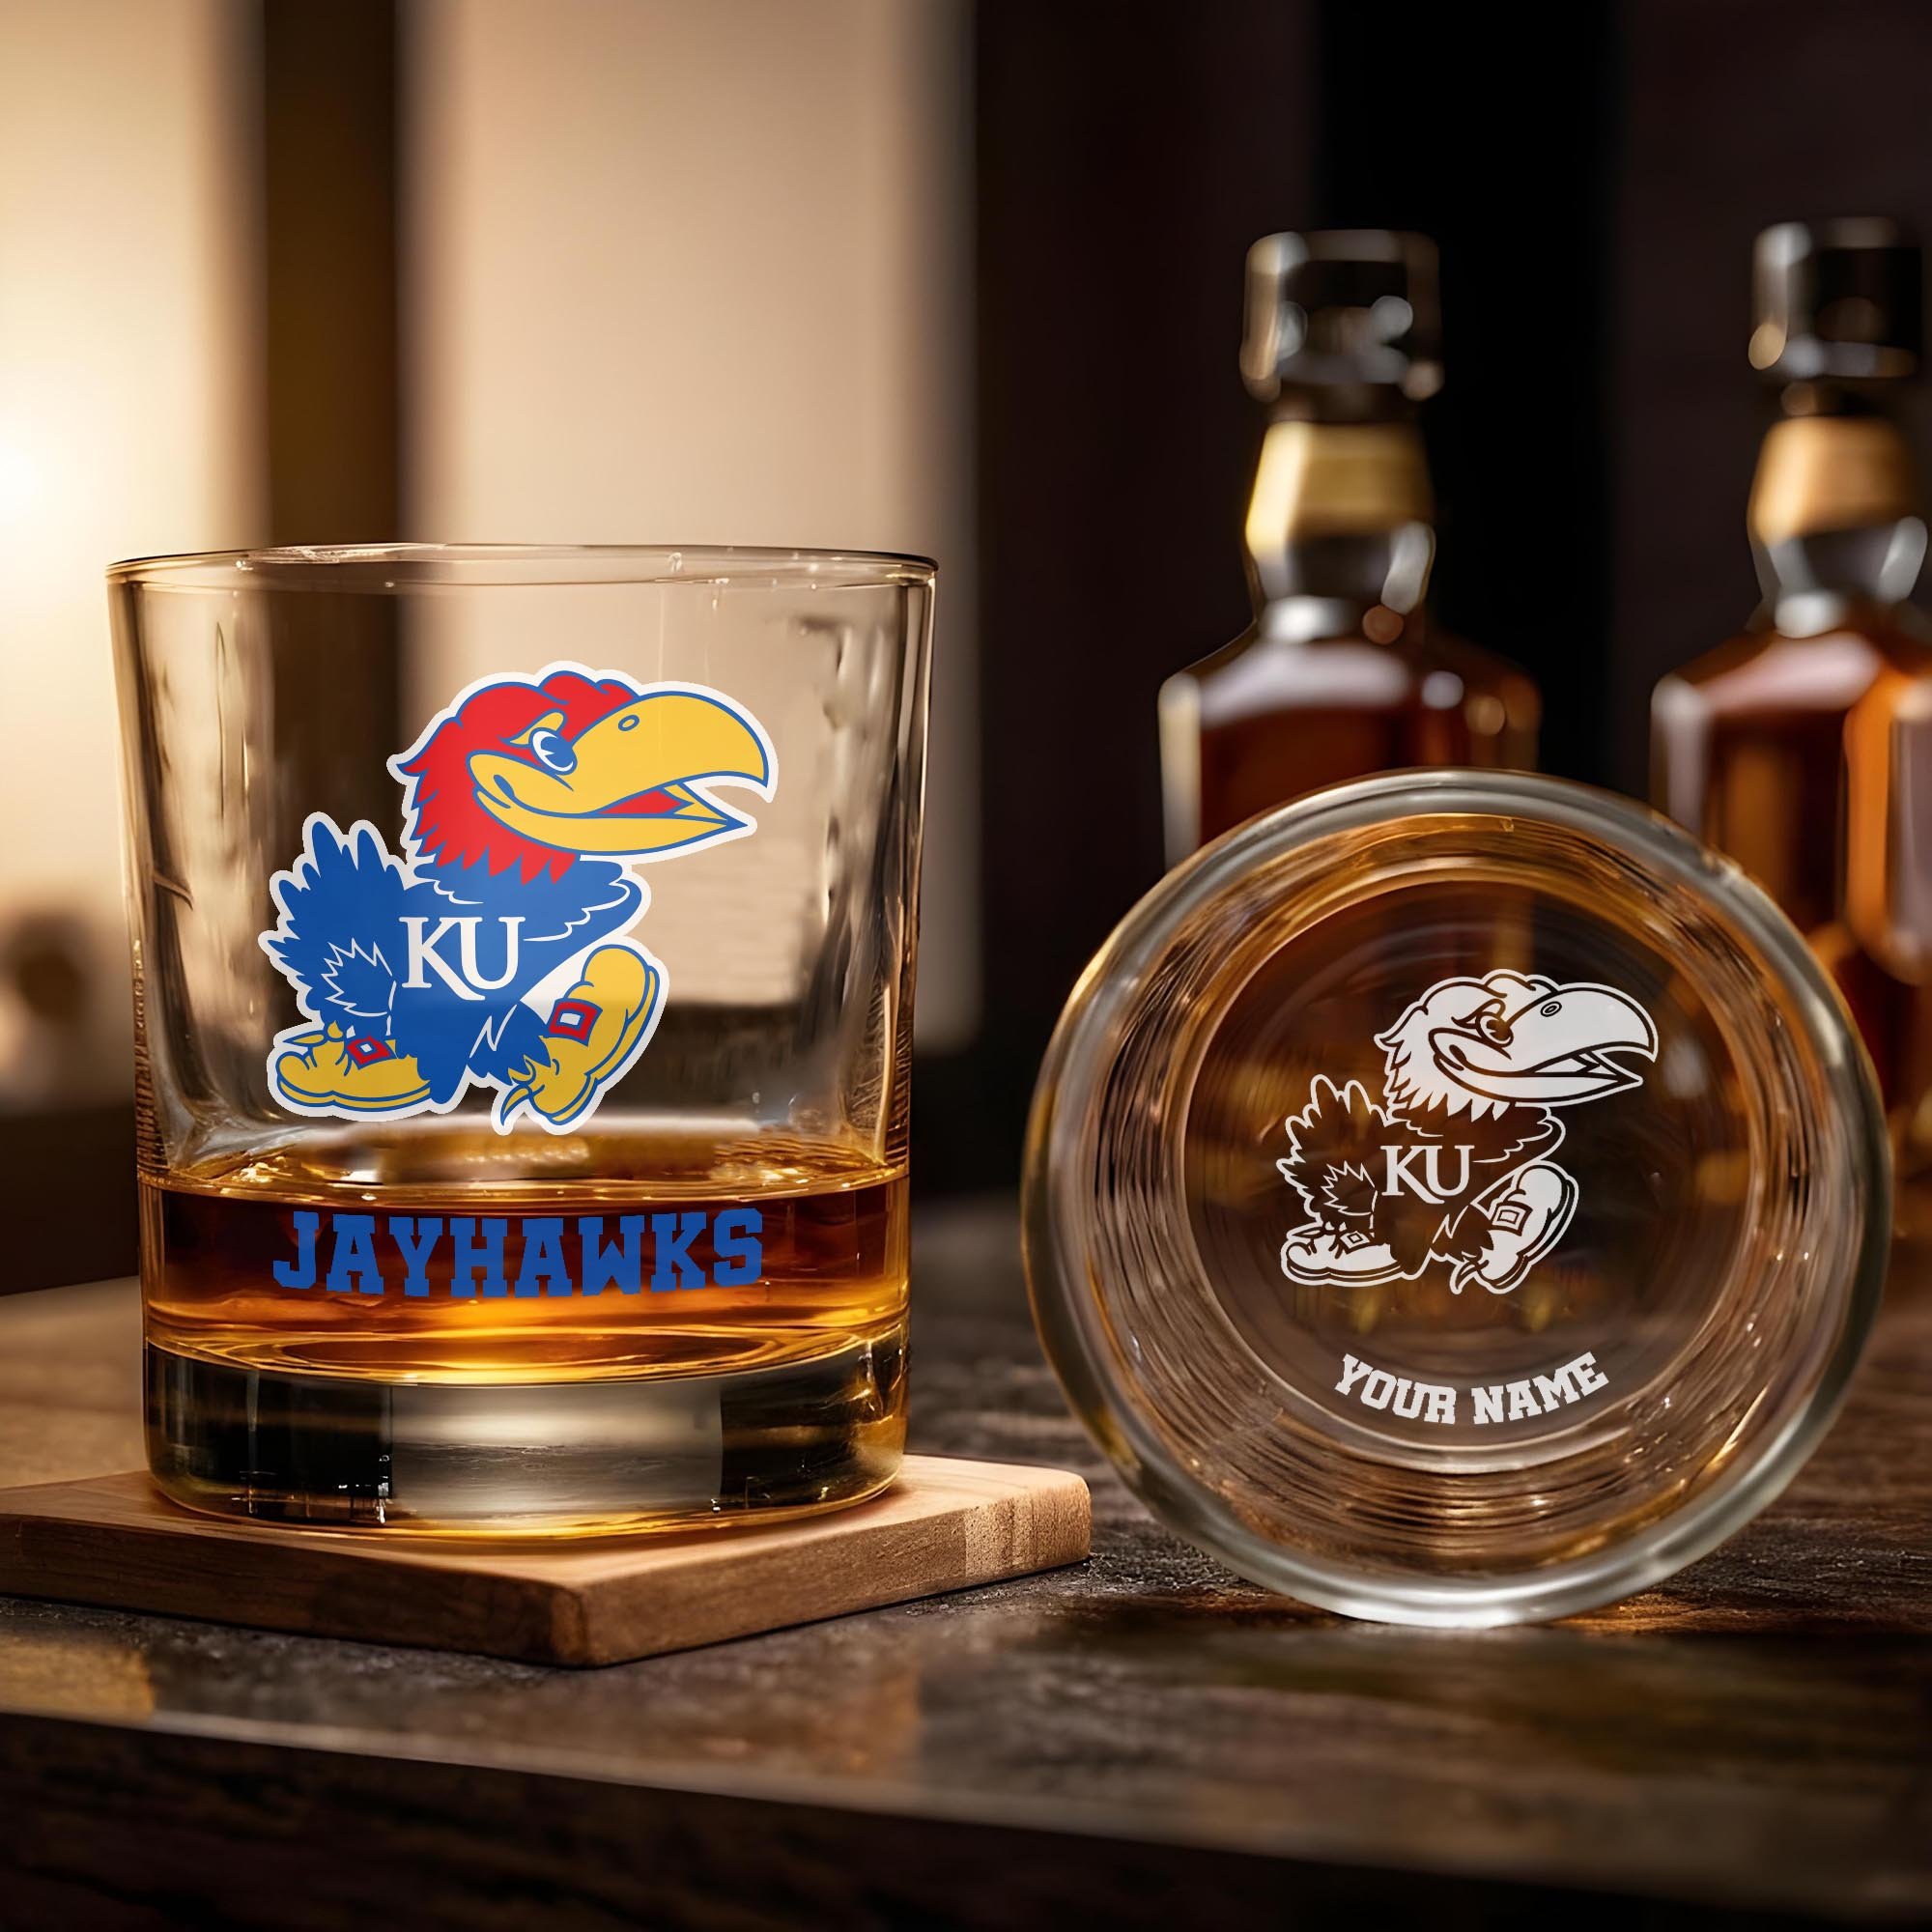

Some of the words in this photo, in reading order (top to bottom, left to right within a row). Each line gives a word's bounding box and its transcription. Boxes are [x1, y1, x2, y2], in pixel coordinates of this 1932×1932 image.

[399, 916, 526, 1001] KU
[1379, 1145, 1475, 1205] KU
[272, 1208, 763, 1298] JAYHAWKS
[1334, 1353, 1456, 1425] YOUR
[1471, 1351, 1609, 1425] NAME
